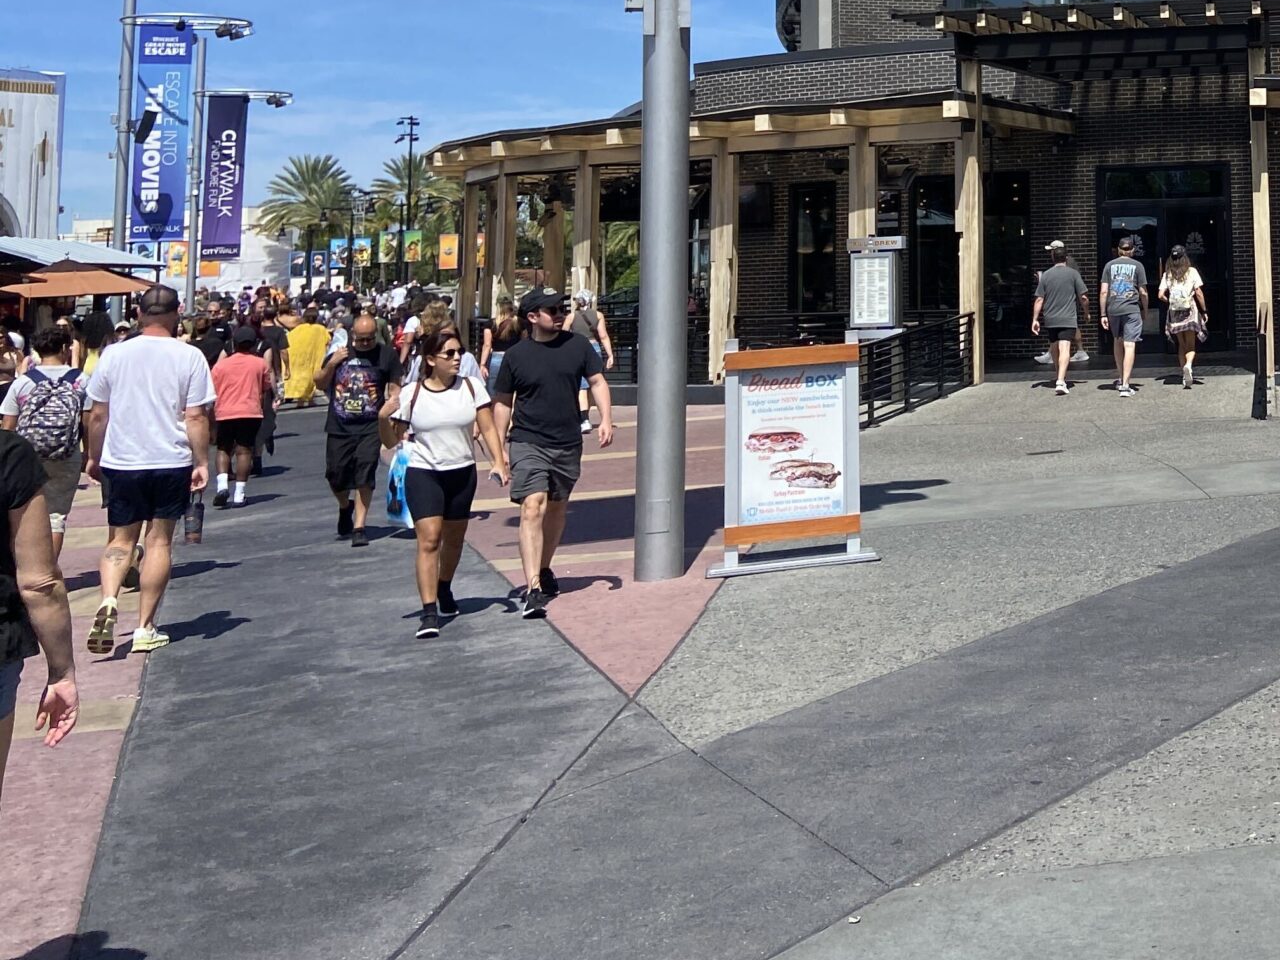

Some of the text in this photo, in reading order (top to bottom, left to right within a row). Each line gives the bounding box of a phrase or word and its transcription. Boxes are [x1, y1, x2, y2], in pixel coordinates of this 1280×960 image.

[144, 48, 186, 56] ESCAPE
[162, 130, 178, 166] INTO
[140, 129, 162, 214] MOVIES
[208, 140, 221, 208] FIND MORE FUN
[218, 129, 237, 218] CITYWALK
[132, 224, 180, 234] CITYWALK
[202, 247, 238, 256] CITYWALK
[747, 370, 838, 392] Bread BOX
